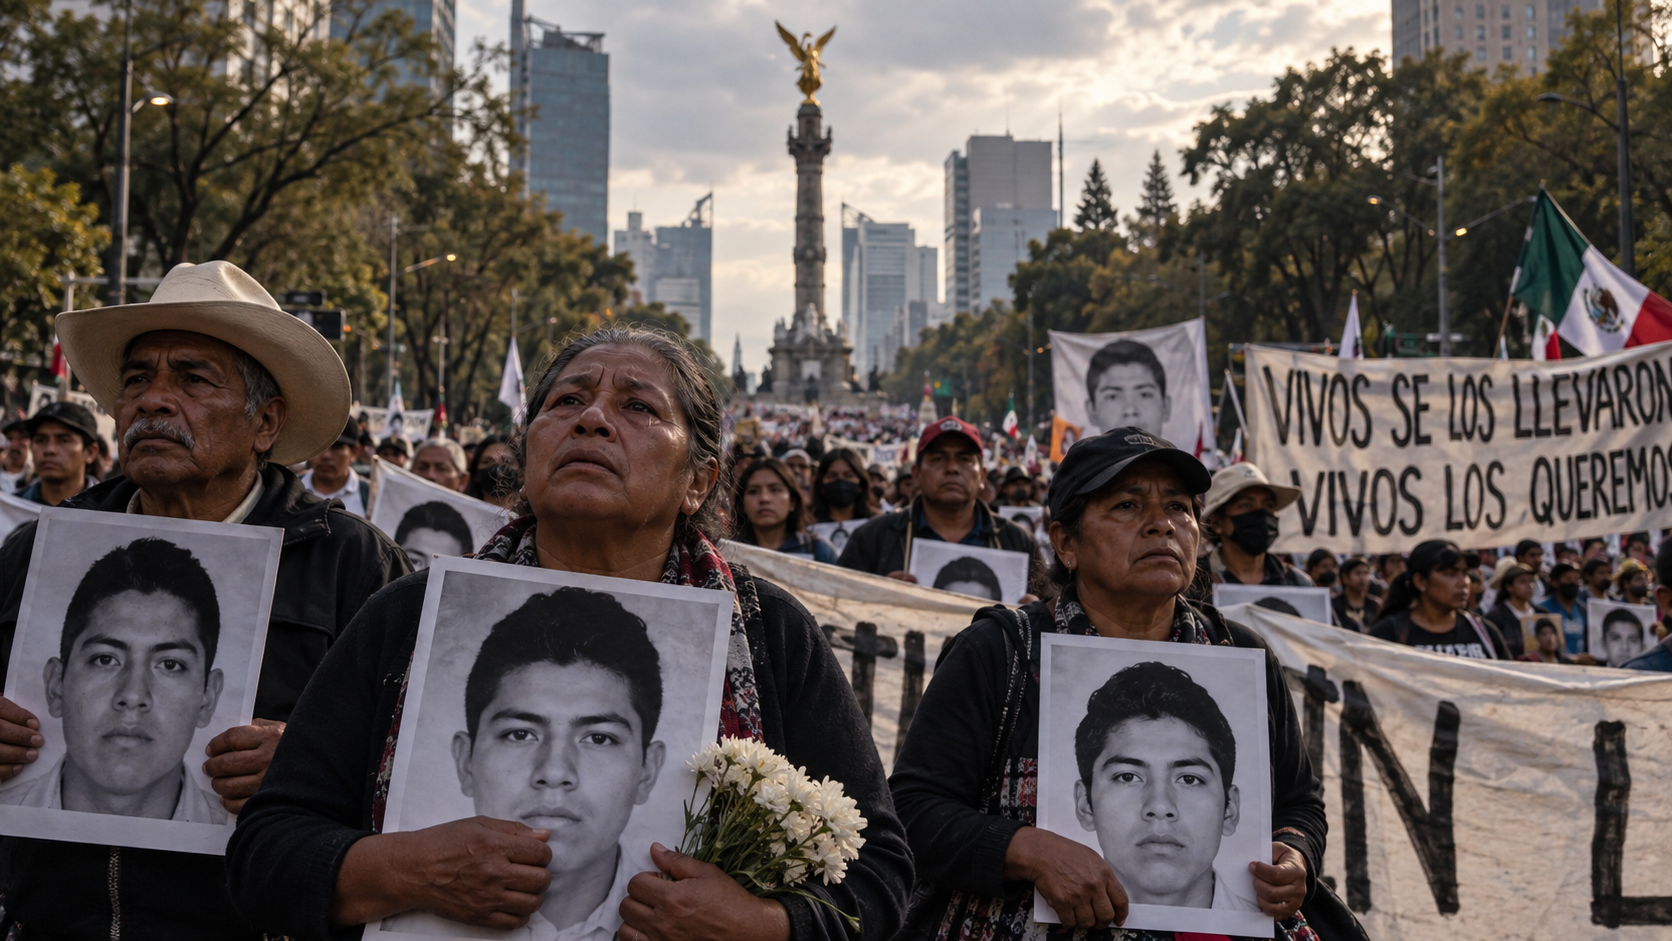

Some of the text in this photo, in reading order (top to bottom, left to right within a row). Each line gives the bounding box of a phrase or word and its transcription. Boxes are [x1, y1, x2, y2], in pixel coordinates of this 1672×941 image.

[1262, 356, 1672, 449] VIVOS SE LOS LLEVARON
[1290, 441, 1672, 537] VIVOS LOS QUEREMO
